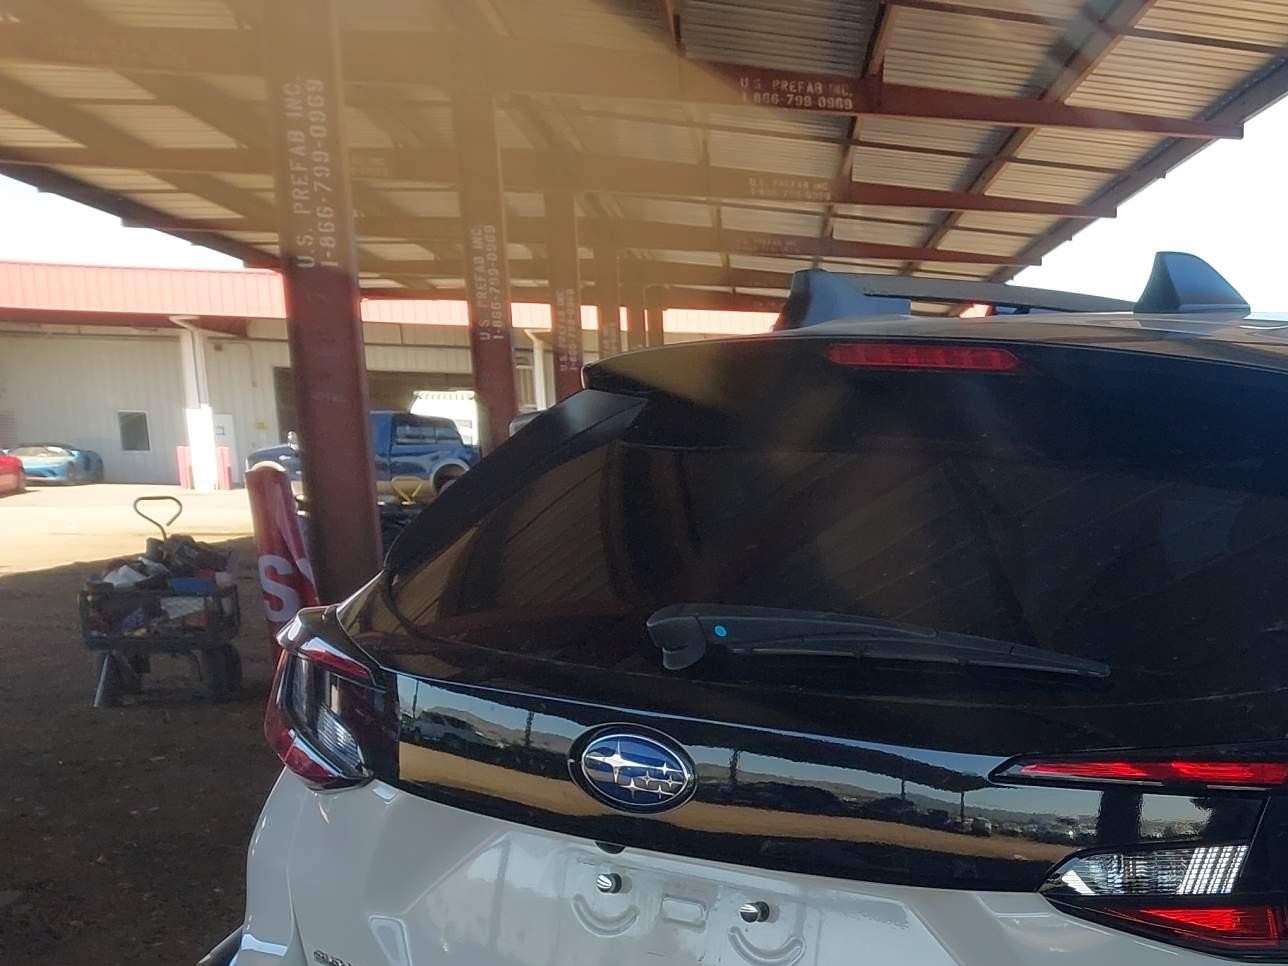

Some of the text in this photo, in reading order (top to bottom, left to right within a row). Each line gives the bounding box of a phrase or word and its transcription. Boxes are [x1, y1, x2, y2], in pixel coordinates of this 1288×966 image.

[772, 80, 823, 94] PREFAB
[288, 129, 312, 214] PREFAB
[297, 229, 316, 269] U.S.
[473, 255, 489, 308] PREFAB
